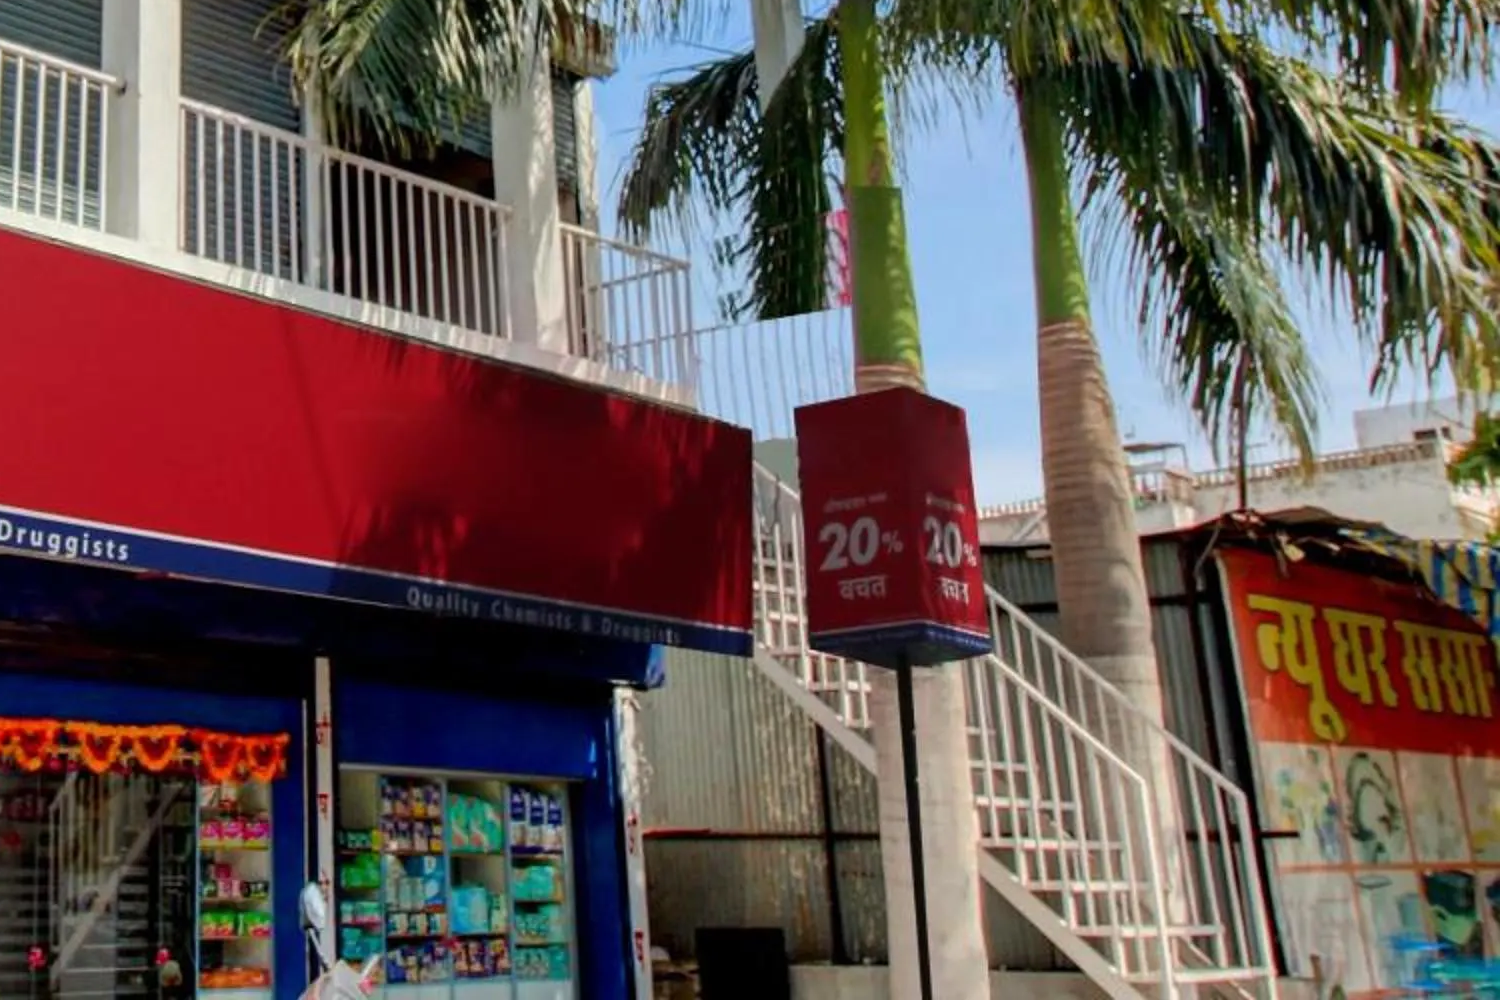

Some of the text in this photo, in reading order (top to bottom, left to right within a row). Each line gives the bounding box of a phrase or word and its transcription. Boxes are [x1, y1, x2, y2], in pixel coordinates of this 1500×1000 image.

[405, 585, 480, 618] Quality
[1247, 593, 1348, 744] न्यू
[1323, 607, 1398, 708] घर
